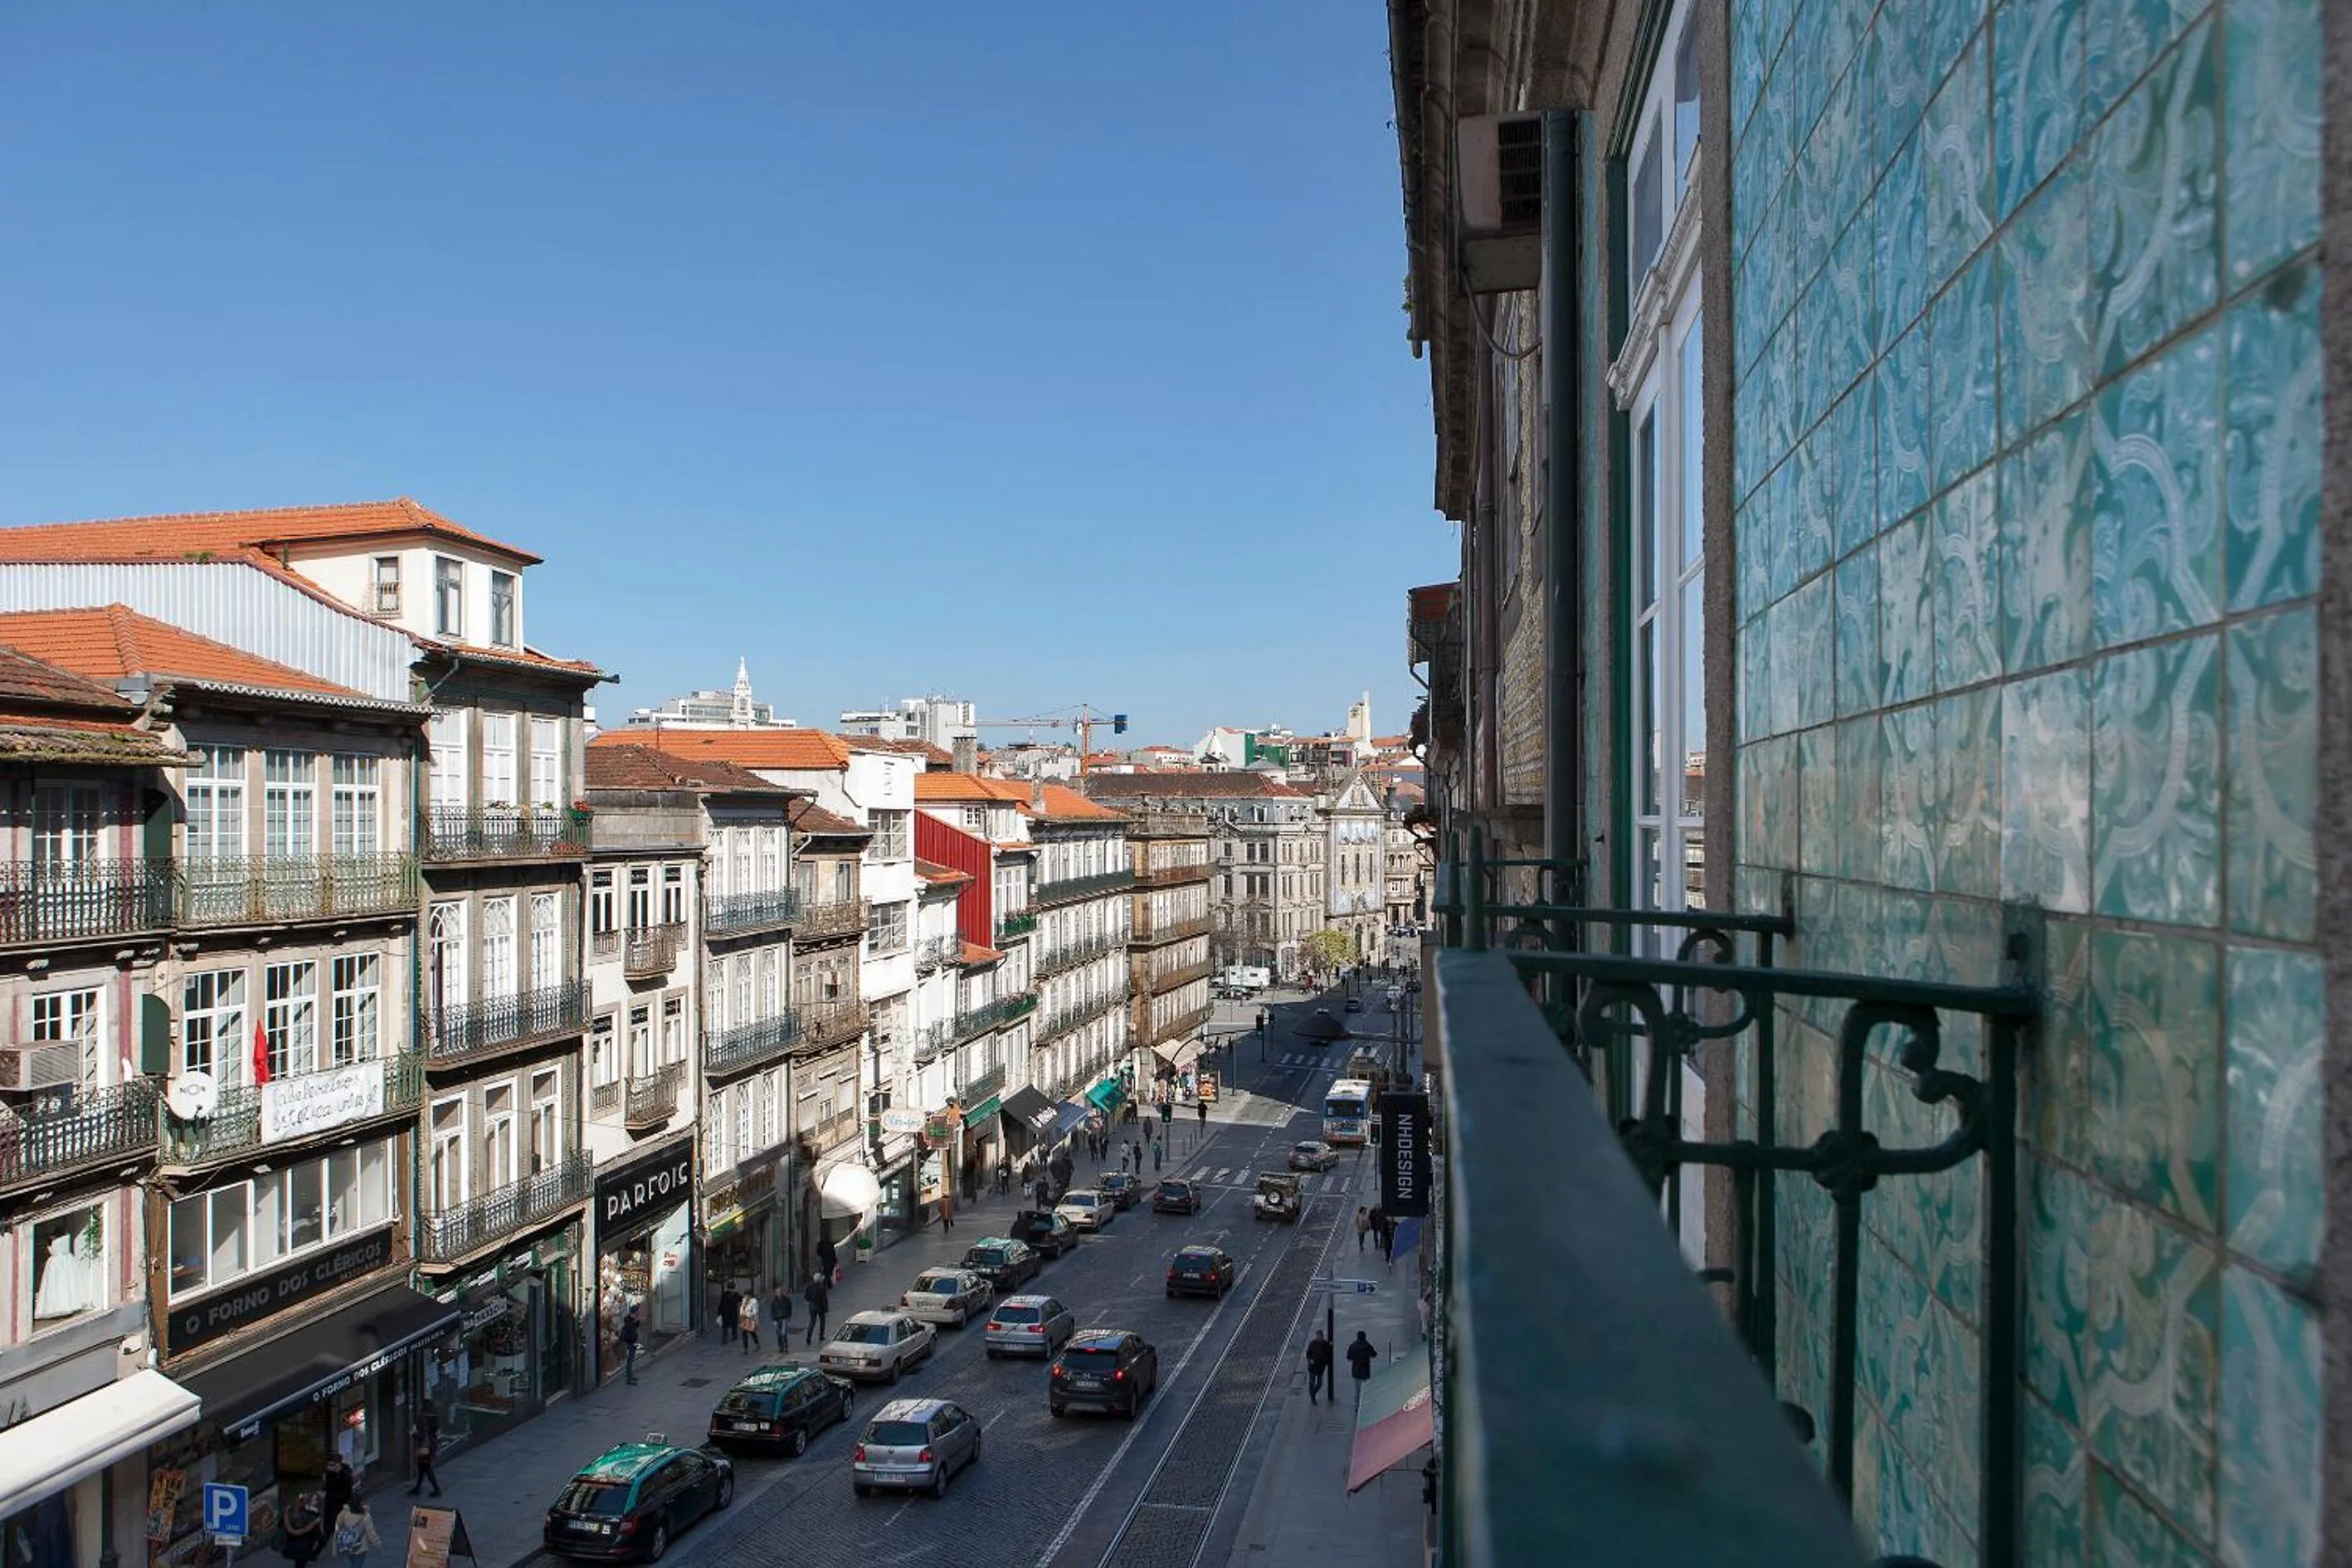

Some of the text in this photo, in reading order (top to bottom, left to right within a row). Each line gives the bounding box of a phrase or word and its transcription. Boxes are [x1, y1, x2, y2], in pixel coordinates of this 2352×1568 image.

[1397, 1113, 1413, 1200] NHDESIGN
[607, 1161, 689, 1221] PARFOIS
[185, 1240, 382, 1335] O FORNO DOS CLÉRIGOS
[312, 1392, 320, 1402] O
[322, 1376, 351, 1398] FORNO
[212, 1488, 237, 1529] P
